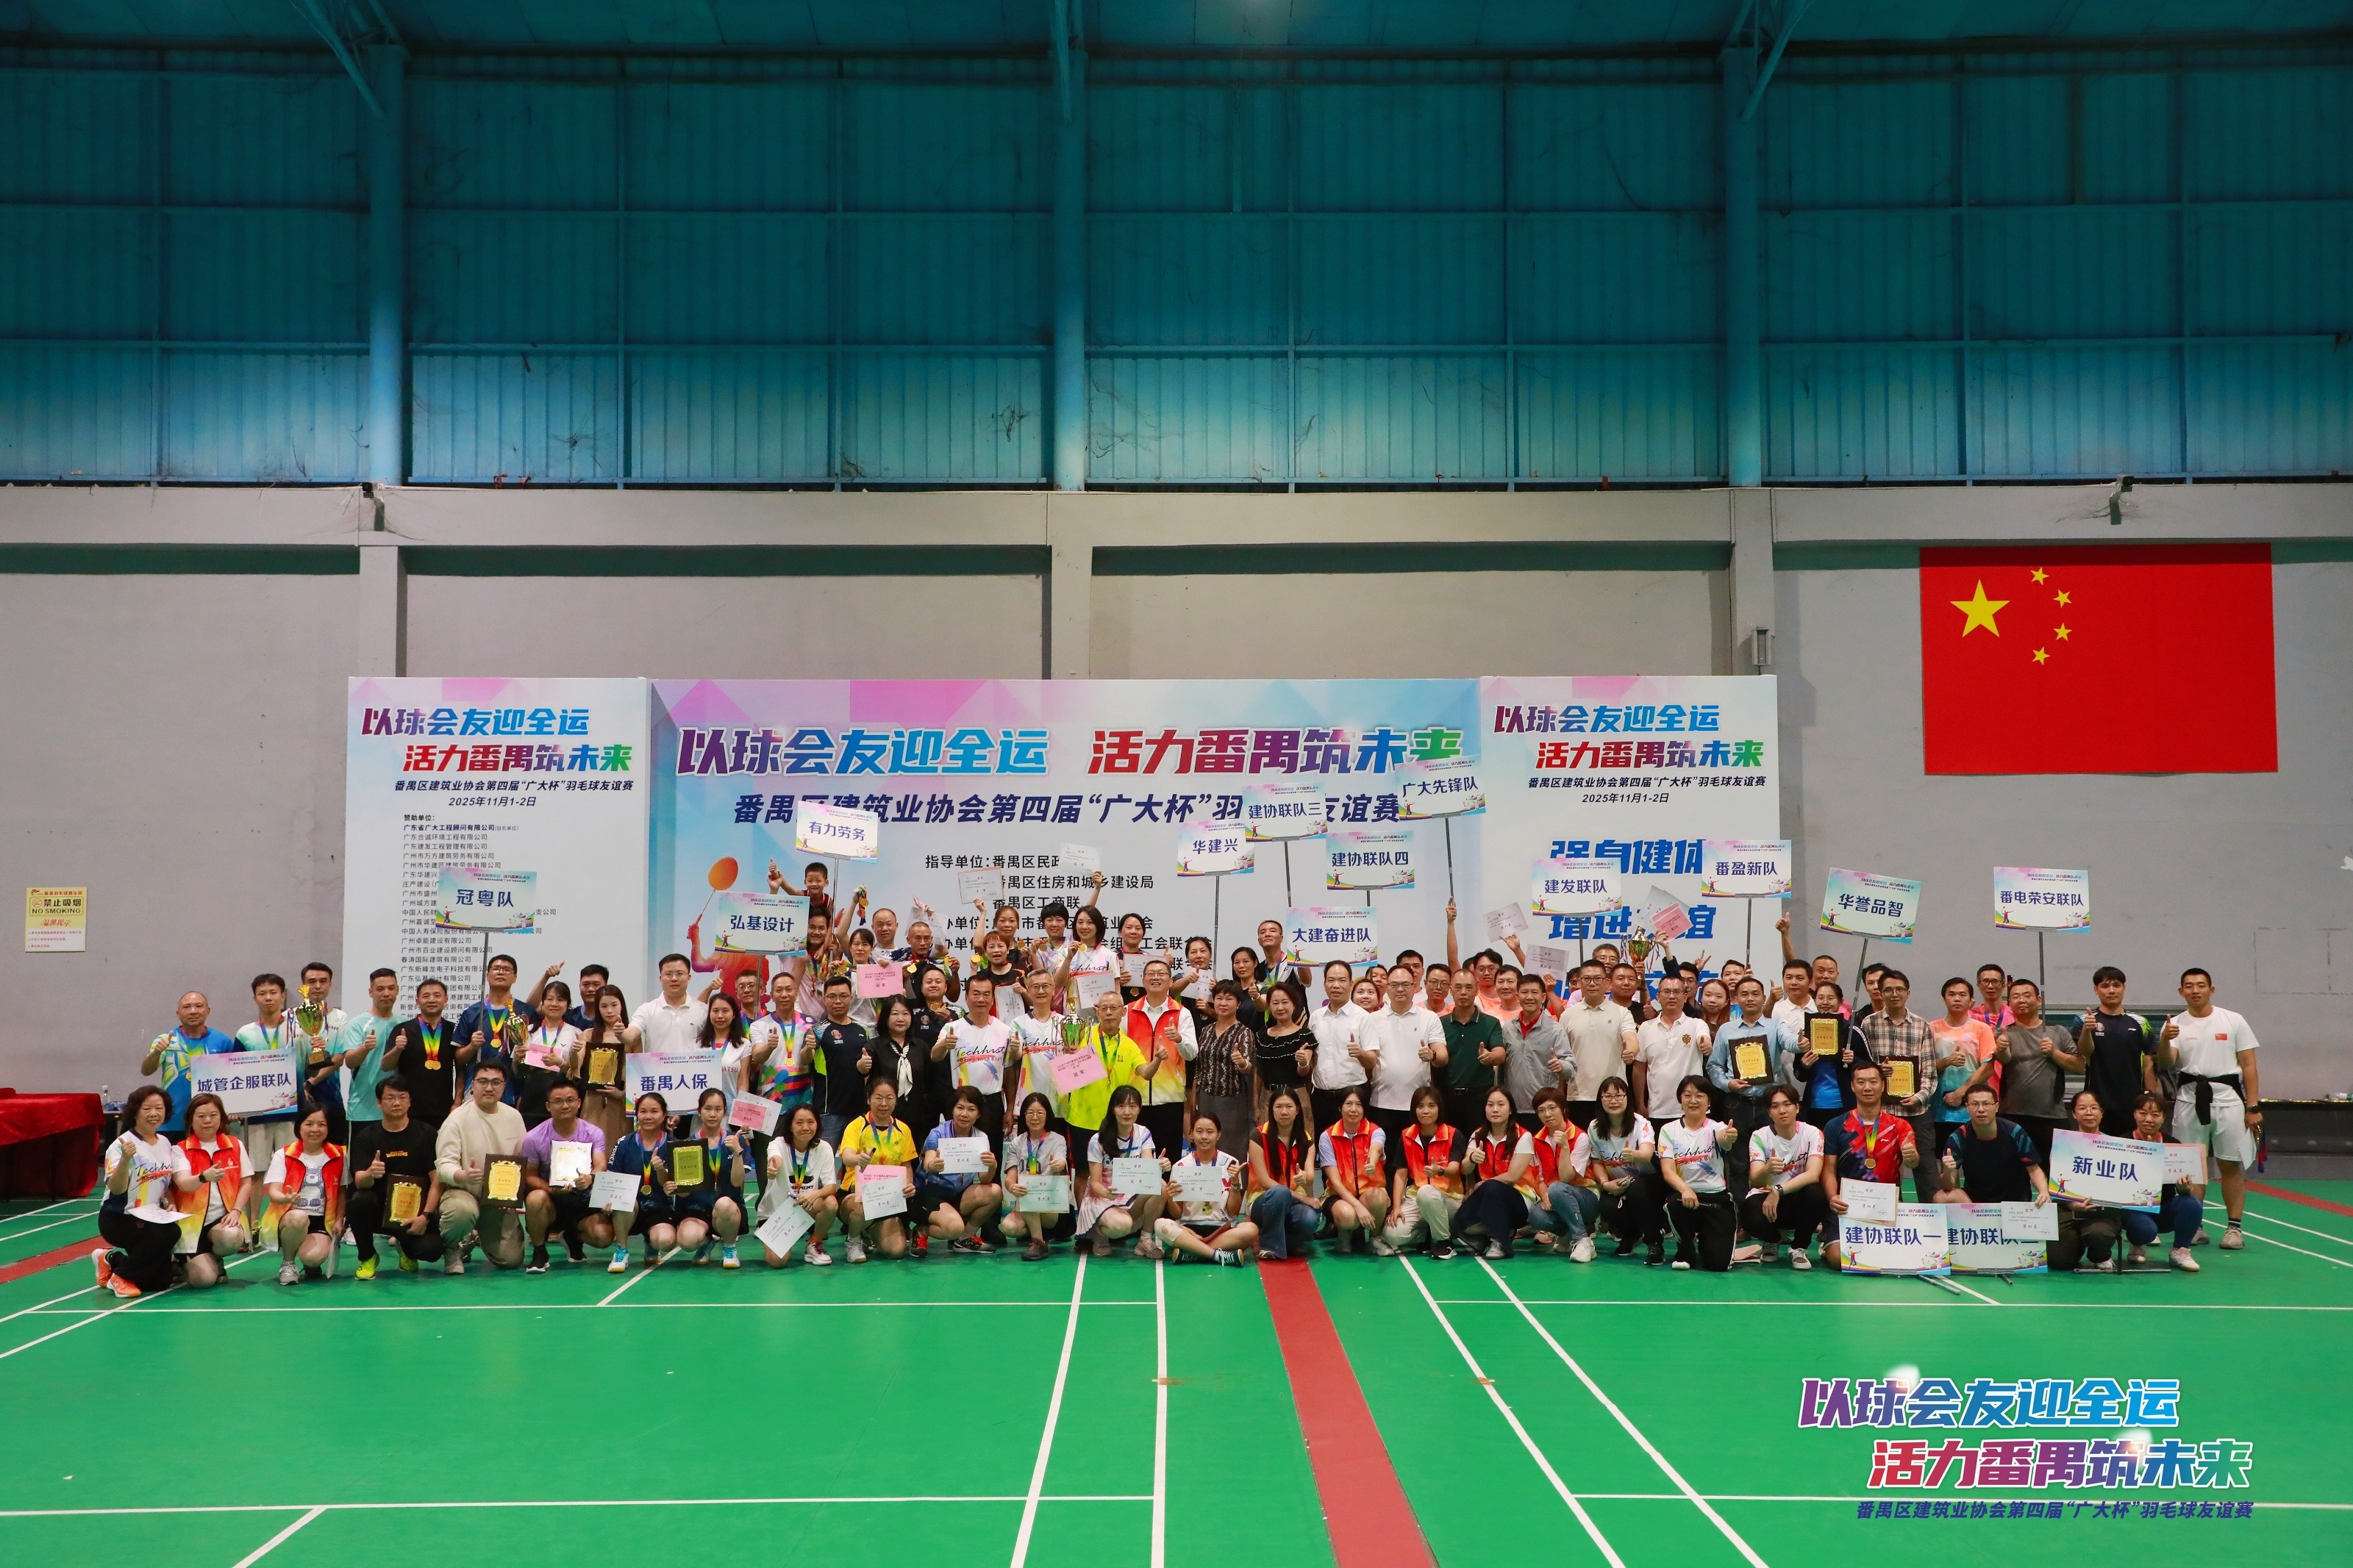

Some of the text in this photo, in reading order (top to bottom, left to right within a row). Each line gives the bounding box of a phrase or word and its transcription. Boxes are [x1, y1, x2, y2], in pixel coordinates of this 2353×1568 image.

[362, 708, 590, 736] 以球会友迎全运
[1494, 705, 1719, 734] 以球会友迎全运
[403, 744, 632, 772] 活力番禺筑未来
[676, 727, 1463, 776] 以球会友迎全运 活力番禺筑未来
[1536, 740, 1764, 769] 活力番禺筑未来
[394, 780, 634, 792] 番禺区建筑业协会第四届“广大杯”羽毛球友谊赛
[1402, 776, 1479, 798] 广大先锋队
[1528, 776, 1766, 788] 番禺区建筑业协会第四届“广大杯”羽毛球友谊赛
[449, 796, 537, 807] 2025年11月1-2日
[1582, 792, 1669, 803] 2025年11月1-2日
[1249, 802, 1323, 817] 建协联队三
[809, 821, 865, 842] 有力劳务
[1192, 838, 1238, 854] 华建兴
[1332, 852, 1410, 867] 建协联队四
[1715, 862, 1778, 876] 番盈新队
[1545, 879, 1607, 894] 建发联队
[43, 898, 81, 907] 禁止吸烟
[456, 889, 514, 908] 冠粤队
[1838, 893, 1904, 918] 华誉品智
[1999, 890, 2084, 908] 番电荣安联队
[729, 914, 795, 934] 弘基设计
[1292, 928, 1372, 944] 大建奋进队
[198, 1075, 292, 1093] 城管企服联队
[640, 1073, 708, 1092] 番禺人保
[608, 1145, 618, 1165] YONEX
[2072, 1156, 2139, 1182] 新业队
[1846, 1226, 1941, 1245] 建协联队一
